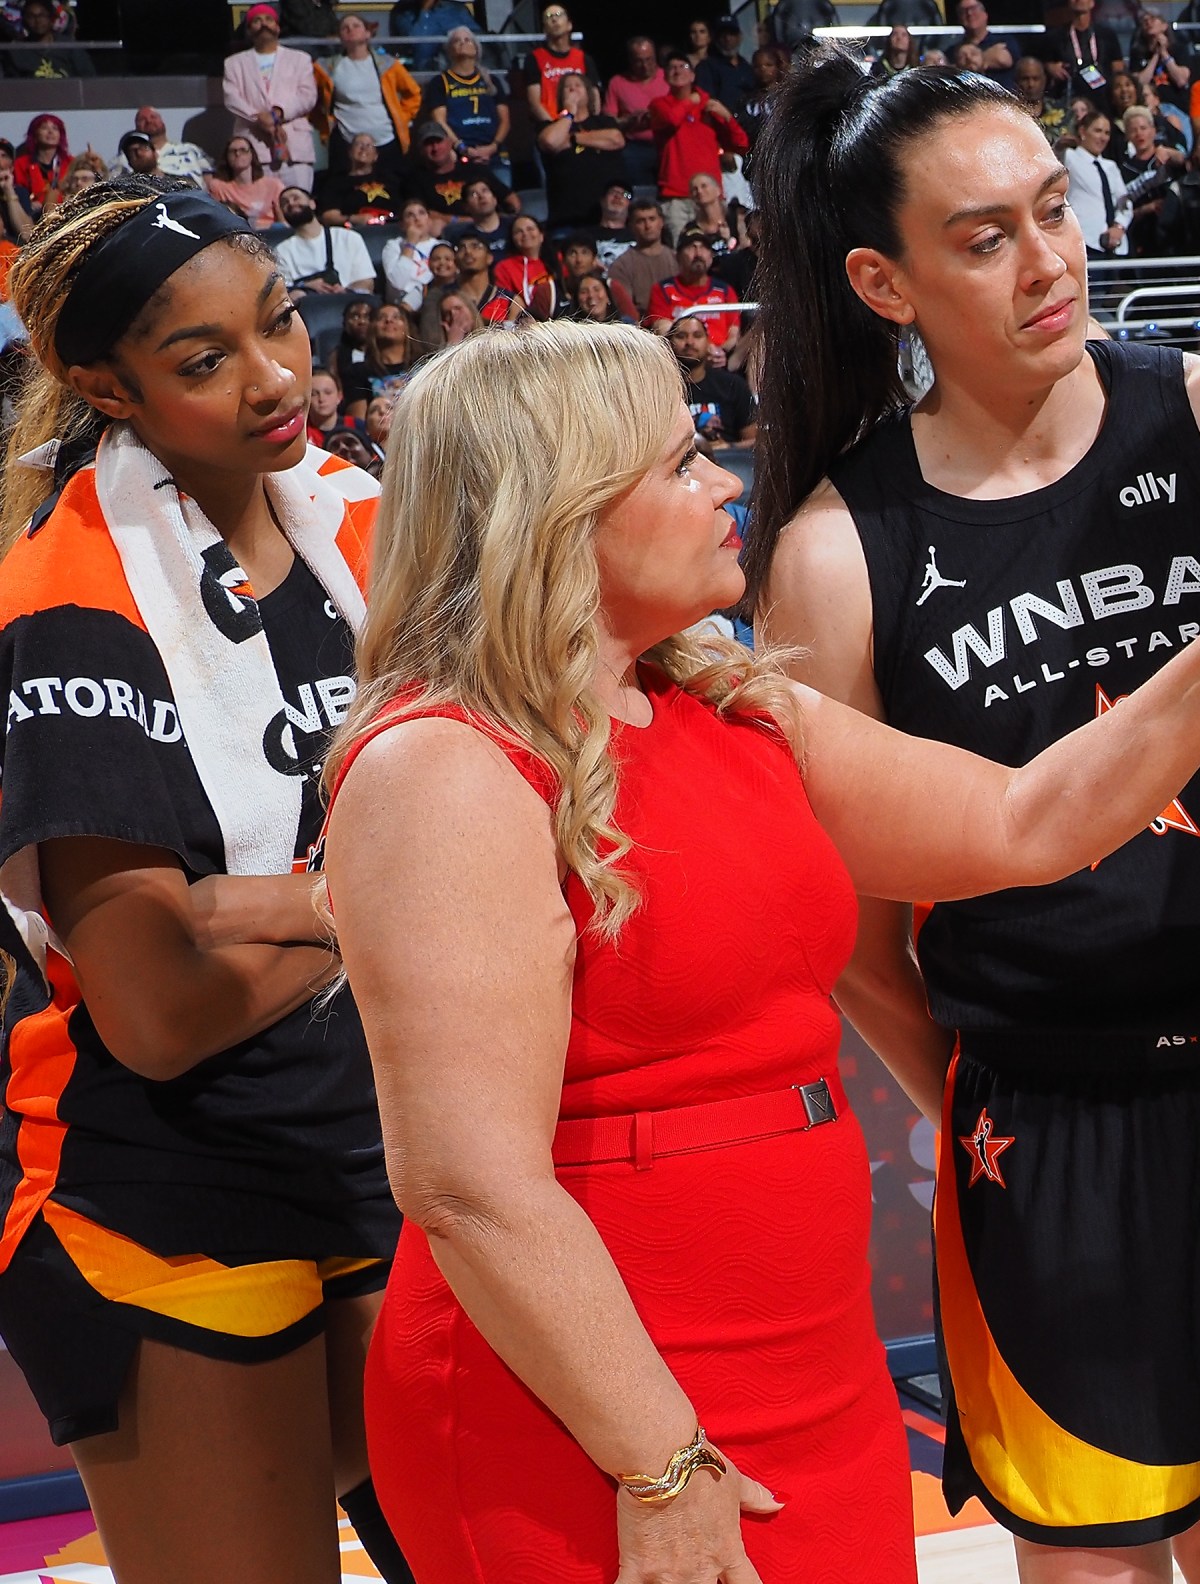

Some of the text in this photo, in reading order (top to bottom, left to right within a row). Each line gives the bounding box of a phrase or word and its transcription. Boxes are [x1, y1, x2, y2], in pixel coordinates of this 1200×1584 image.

[469, 95, 479, 114] 7
[1119, 472, 1177, 507] ally
[6, 677, 187, 747] ATORAD
